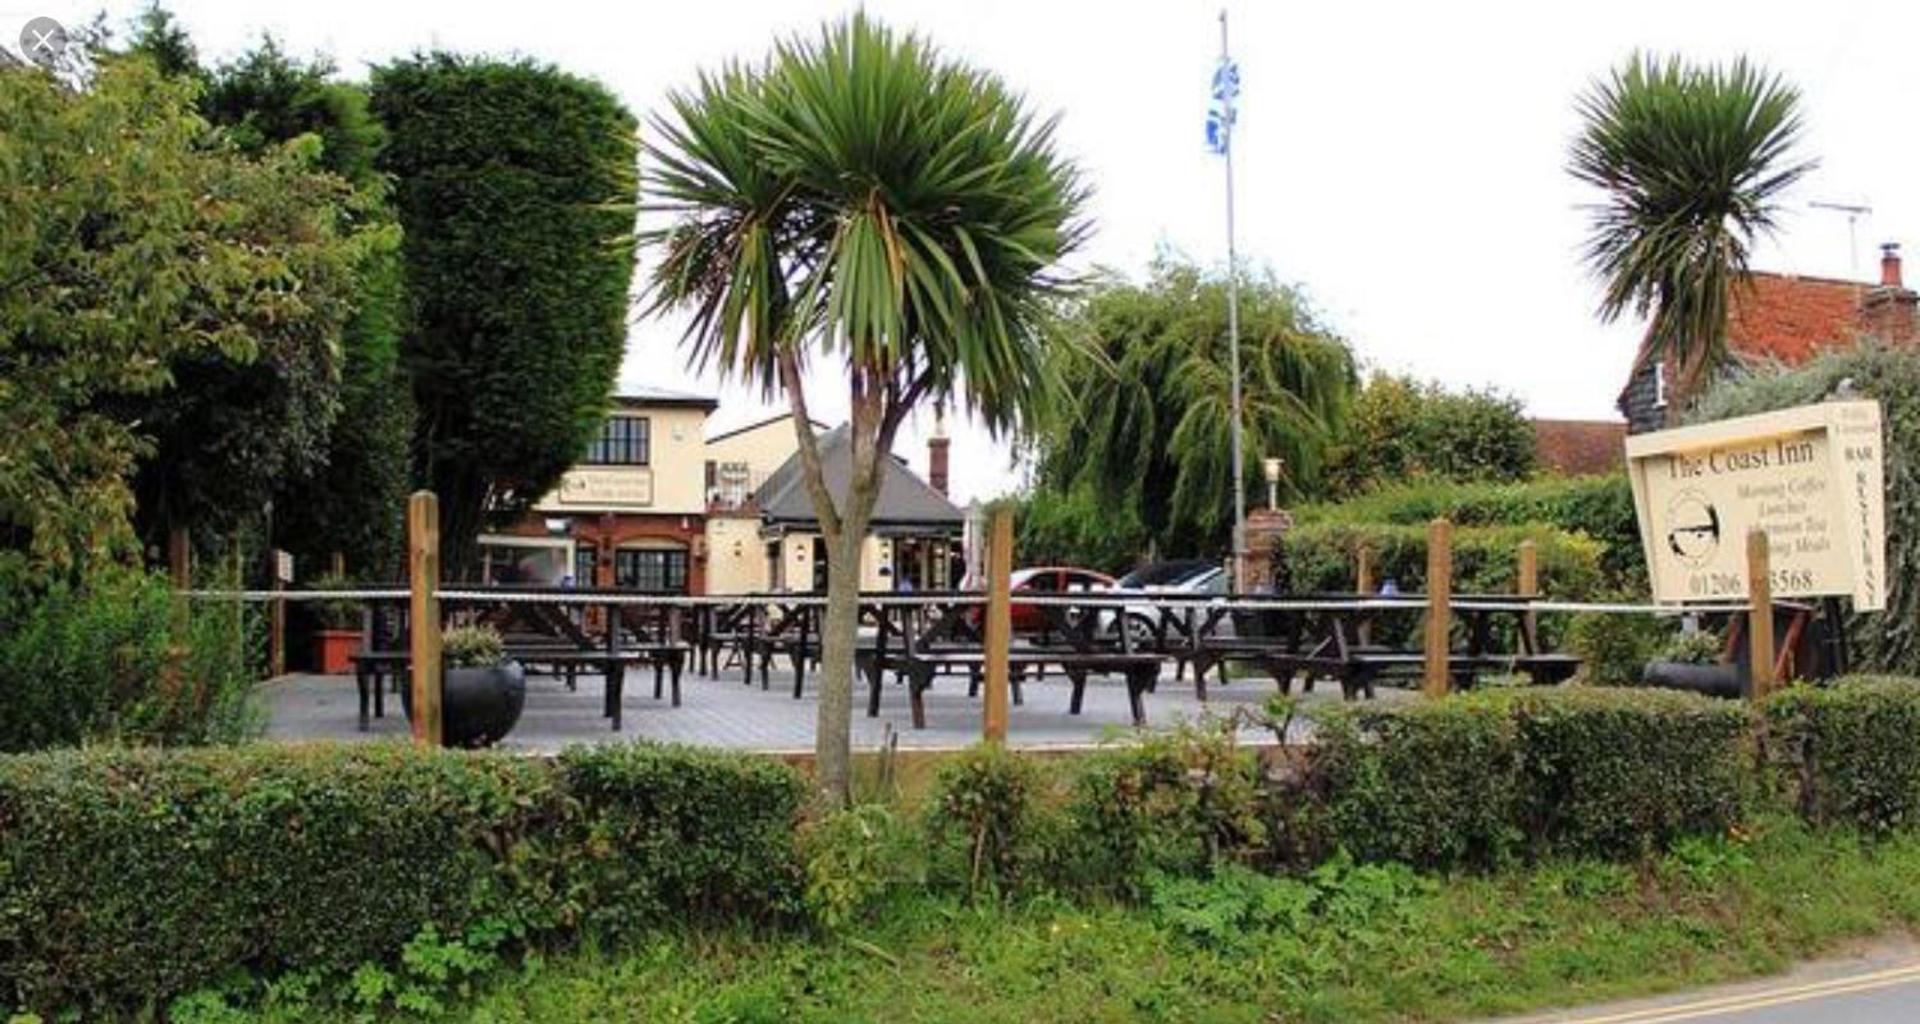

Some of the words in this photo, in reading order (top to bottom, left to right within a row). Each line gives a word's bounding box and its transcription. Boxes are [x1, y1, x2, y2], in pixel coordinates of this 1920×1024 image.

[1668, 452, 1703, 478] The
[1709, 446, 1769, 474] Coast
[1776, 439, 1814, 466] Inn
[1690, 572, 1741, 595] 01206
[1769, 569, 1812, 593] 3568
